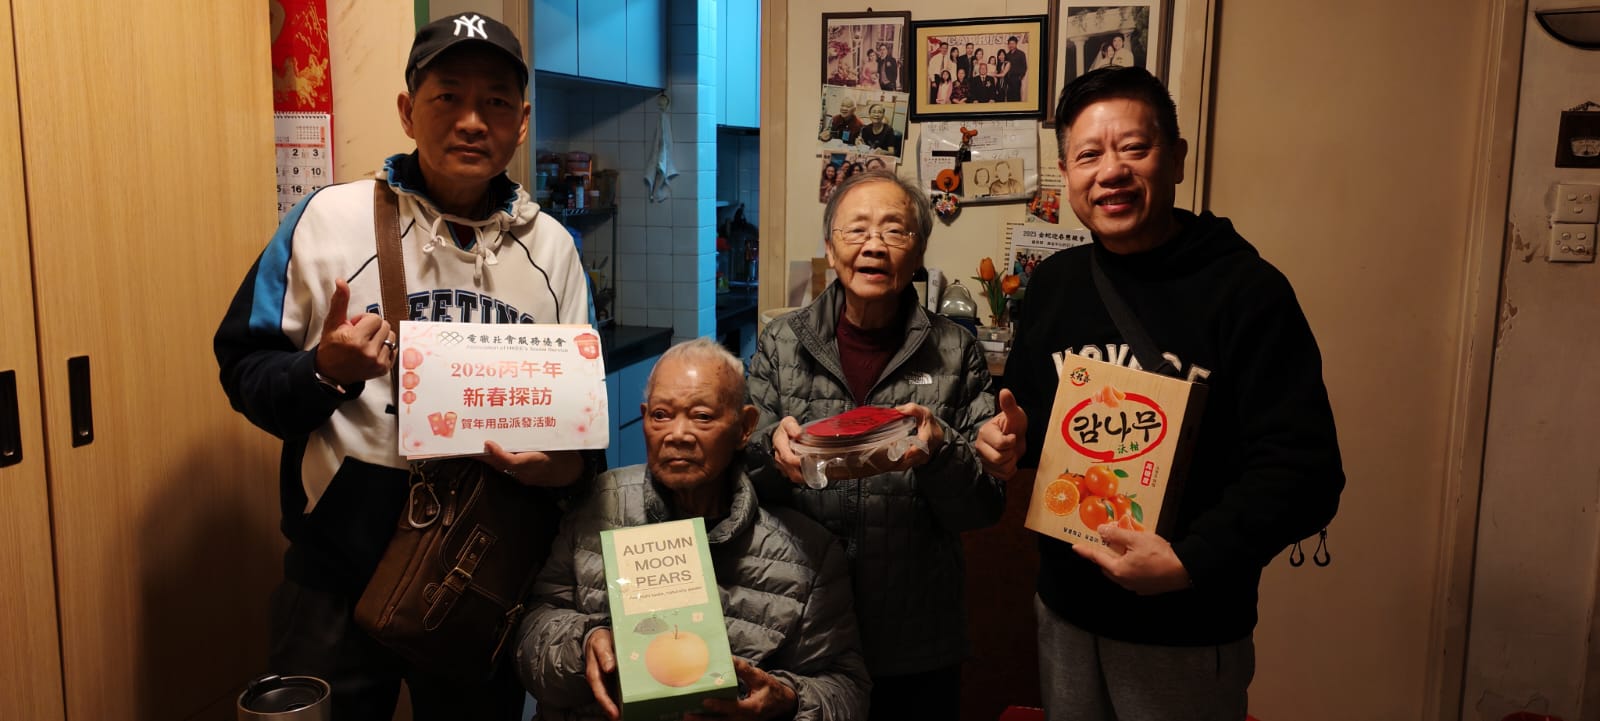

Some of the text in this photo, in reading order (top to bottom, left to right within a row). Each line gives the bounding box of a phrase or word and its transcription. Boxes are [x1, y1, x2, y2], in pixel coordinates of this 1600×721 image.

[453, 14, 488, 39] NY
[292, 148, 319, 157] 2 3
[293, 166, 322, 176] 9 10
[291, 186, 302, 194] 16
[451, 361, 564, 378] 2026丙午年
[463, 387, 552, 408] 新春探訪
[461, 416, 556, 430] 賀年用品派發活動
[1073, 411, 1161, 444] 감나무
[623, 536, 693, 556] AUTUMN
[635, 554, 687, 572] MOON
[636, 570, 692, 588] PEARS
